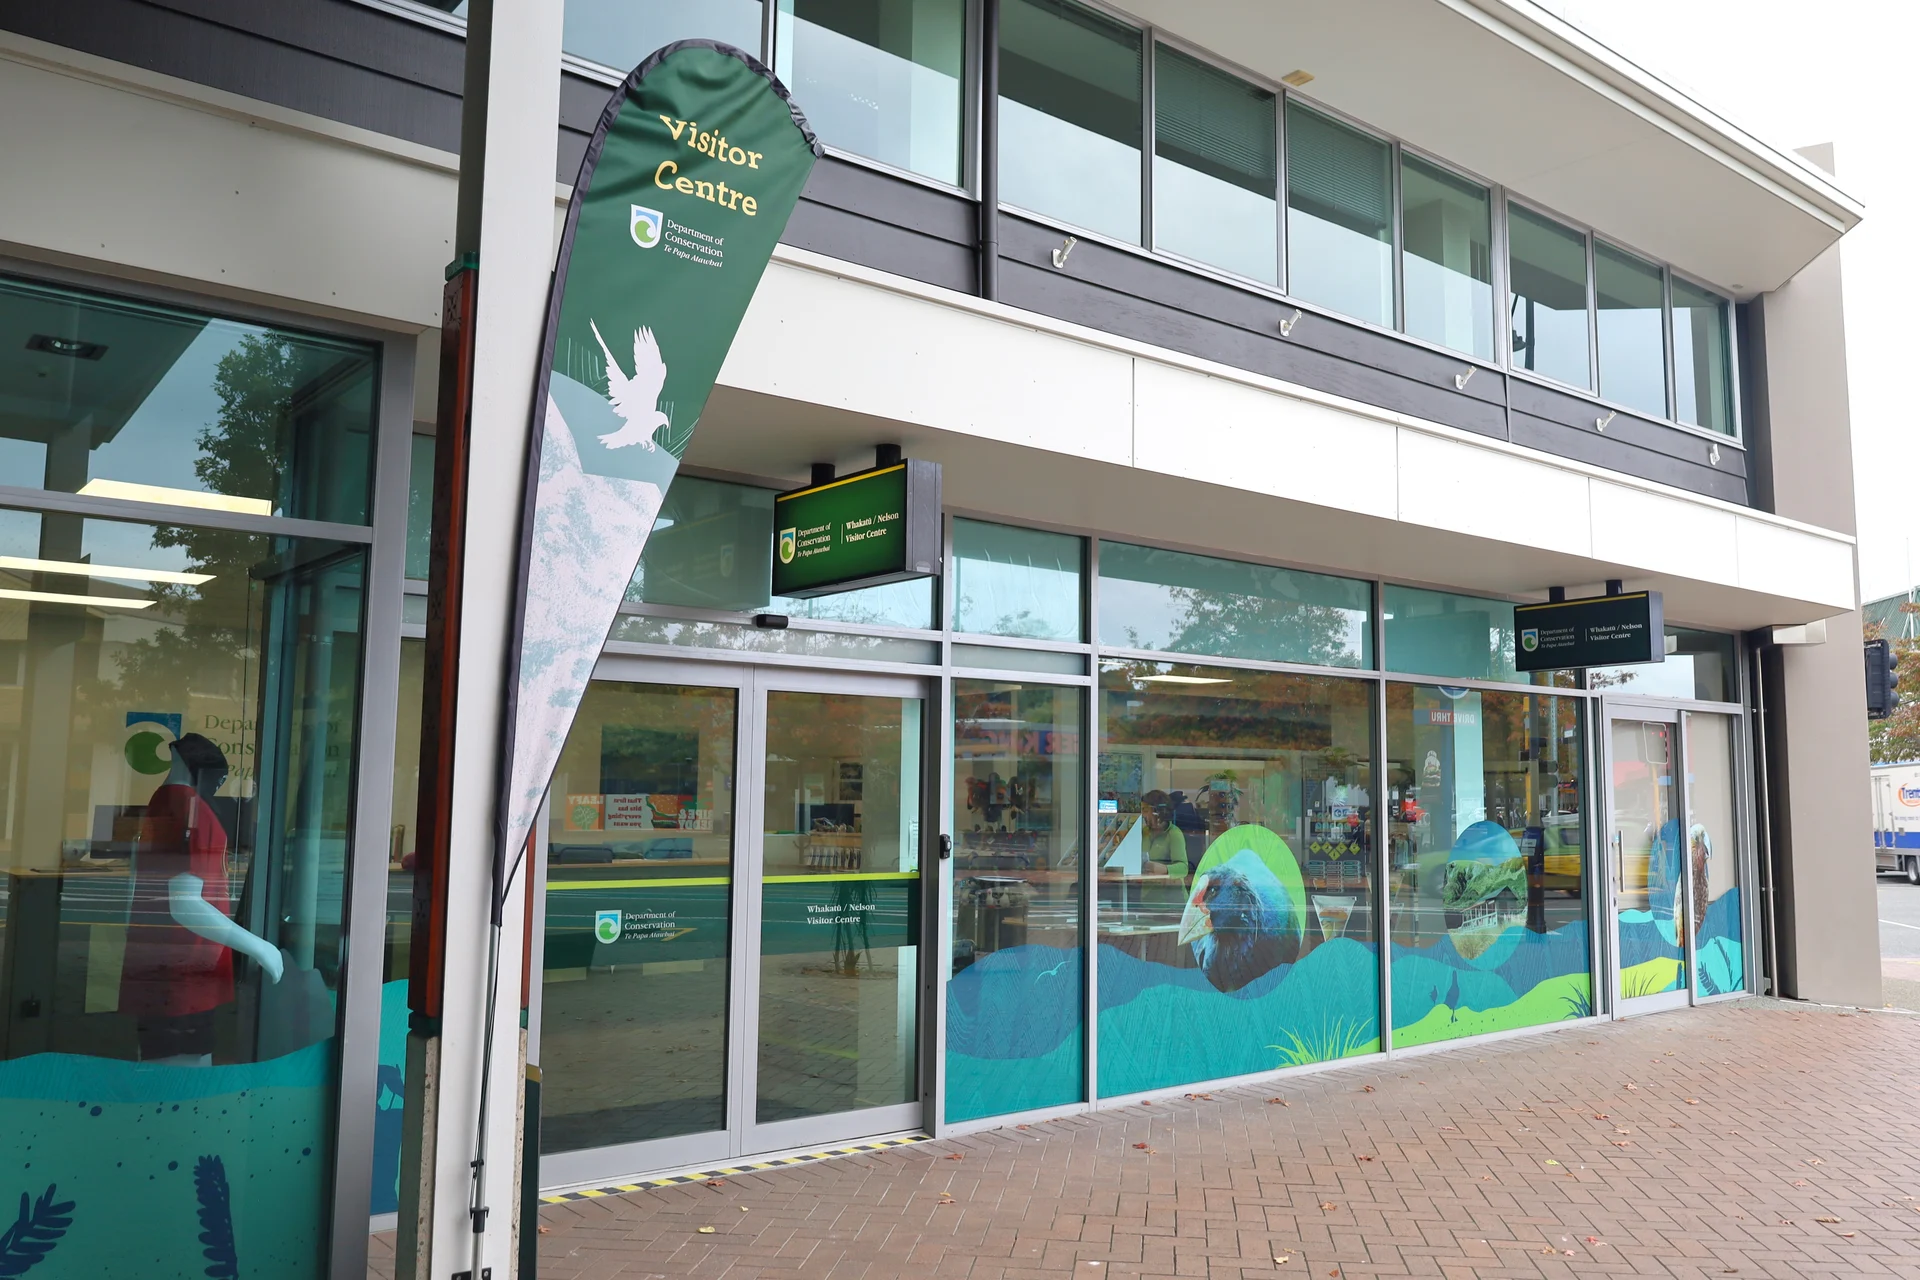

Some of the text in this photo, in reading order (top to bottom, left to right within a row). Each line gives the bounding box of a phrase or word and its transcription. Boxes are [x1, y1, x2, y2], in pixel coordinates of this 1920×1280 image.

[659, 114, 763, 170] Visitor
[654, 160, 758, 216] Centre
[667, 219, 725, 246] Department of
[665, 231, 724, 258] Conservation
[664, 244, 723, 268] Te Papa Atawhai
[877, 511, 899, 524] Nelson
[797, 522, 832, 537] Department of
[845, 527, 887, 543] Visitor Centre
[797, 534, 831, 548] Conservation
[1540, 634, 1575, 642] Conservation
[849, 903, 876, 911] Nelson
[625, 910, 676, 921] Department of
[806, 915, 861, 925] Visitor Centre
[624, 921, 675, 931] Conservation
